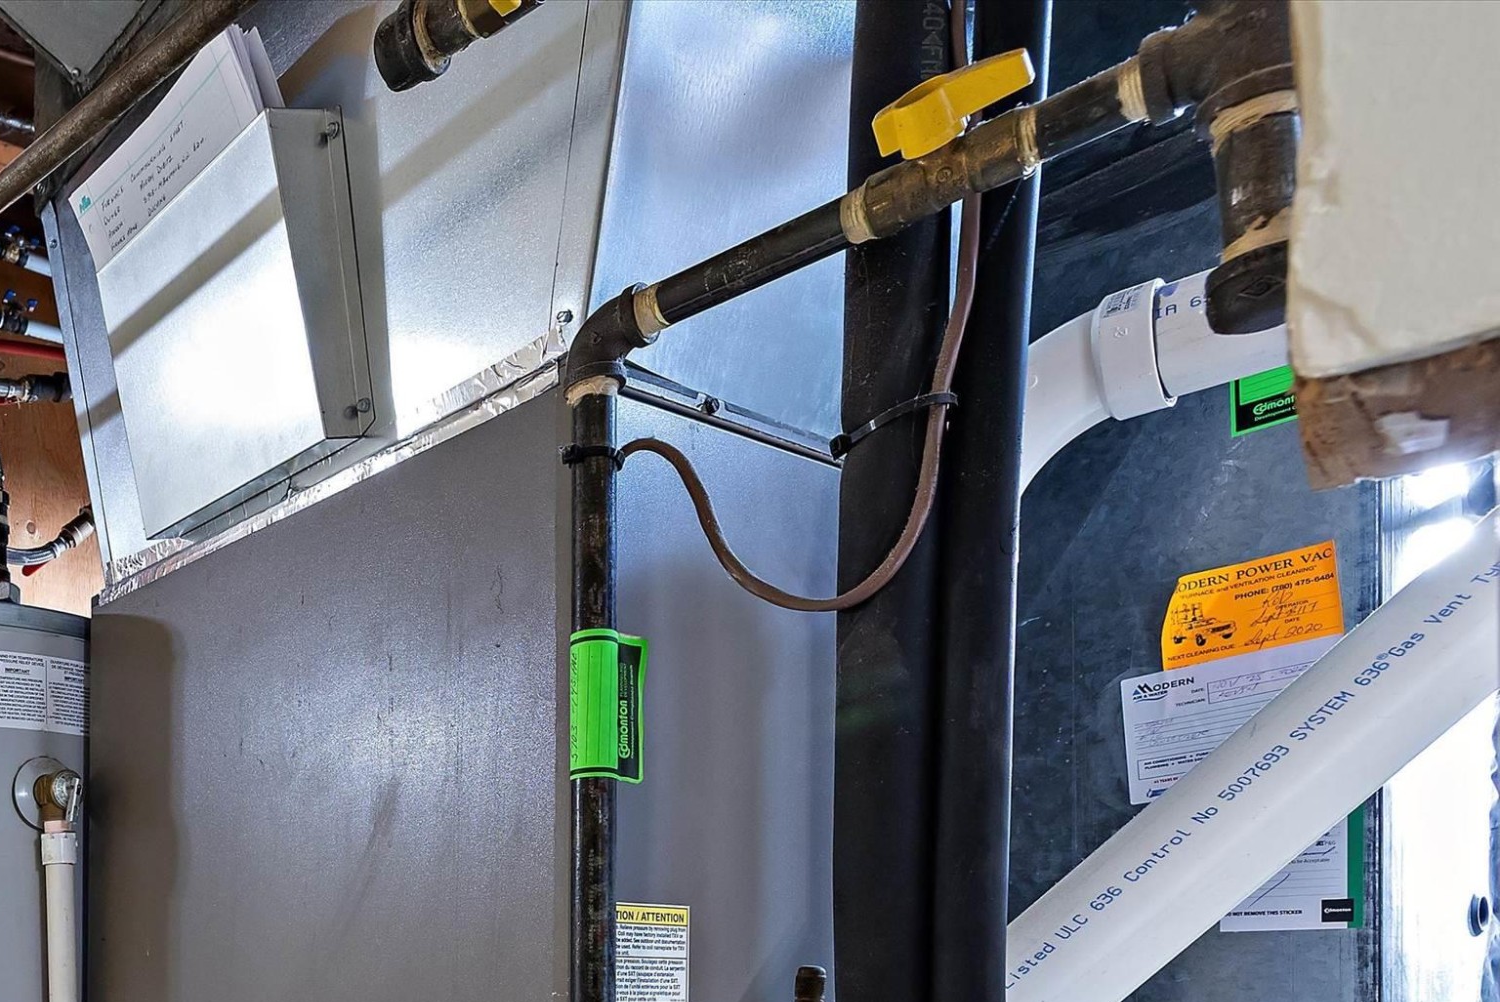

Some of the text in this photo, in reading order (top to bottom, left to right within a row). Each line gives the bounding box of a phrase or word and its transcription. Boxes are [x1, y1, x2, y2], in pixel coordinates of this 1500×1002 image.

[1176, 547, 1333, 594] ODERN POWER VAC
[1216, 585, 1229, 593] and
[1230, 576, 1276, 592] VENTILATION
[1234, 572, 1335, 601] PHONE: (780) 475-6484
[1284, 616, 1300, 624] DATE
[1167, 655, 1185, 663] NEXT
[1186, 646, 1220, 659] CLEANING
[1136, 676, 1195, 694] MODERN
[1132, 694, 1144, 702] AIR
[1148, 691, 1168, 699] WATER
[618, 699, 631, 759] Edmonton
[1055, 912, 1089, 940] ULC
[1090, 884, 1123, 914] 636
[1123, 827, 1192, 884] Control
[1191, 805, 1219, 826] No
[1218, 744, 1291, 802] 5007693
[1290, 689, 1356, 743] SYSTEM
[1423, 593, 1472, 625] Vent
[1152, 756, 1187, 765] CONDITIONING
[641, 911, 685, 923] ATTENTION
